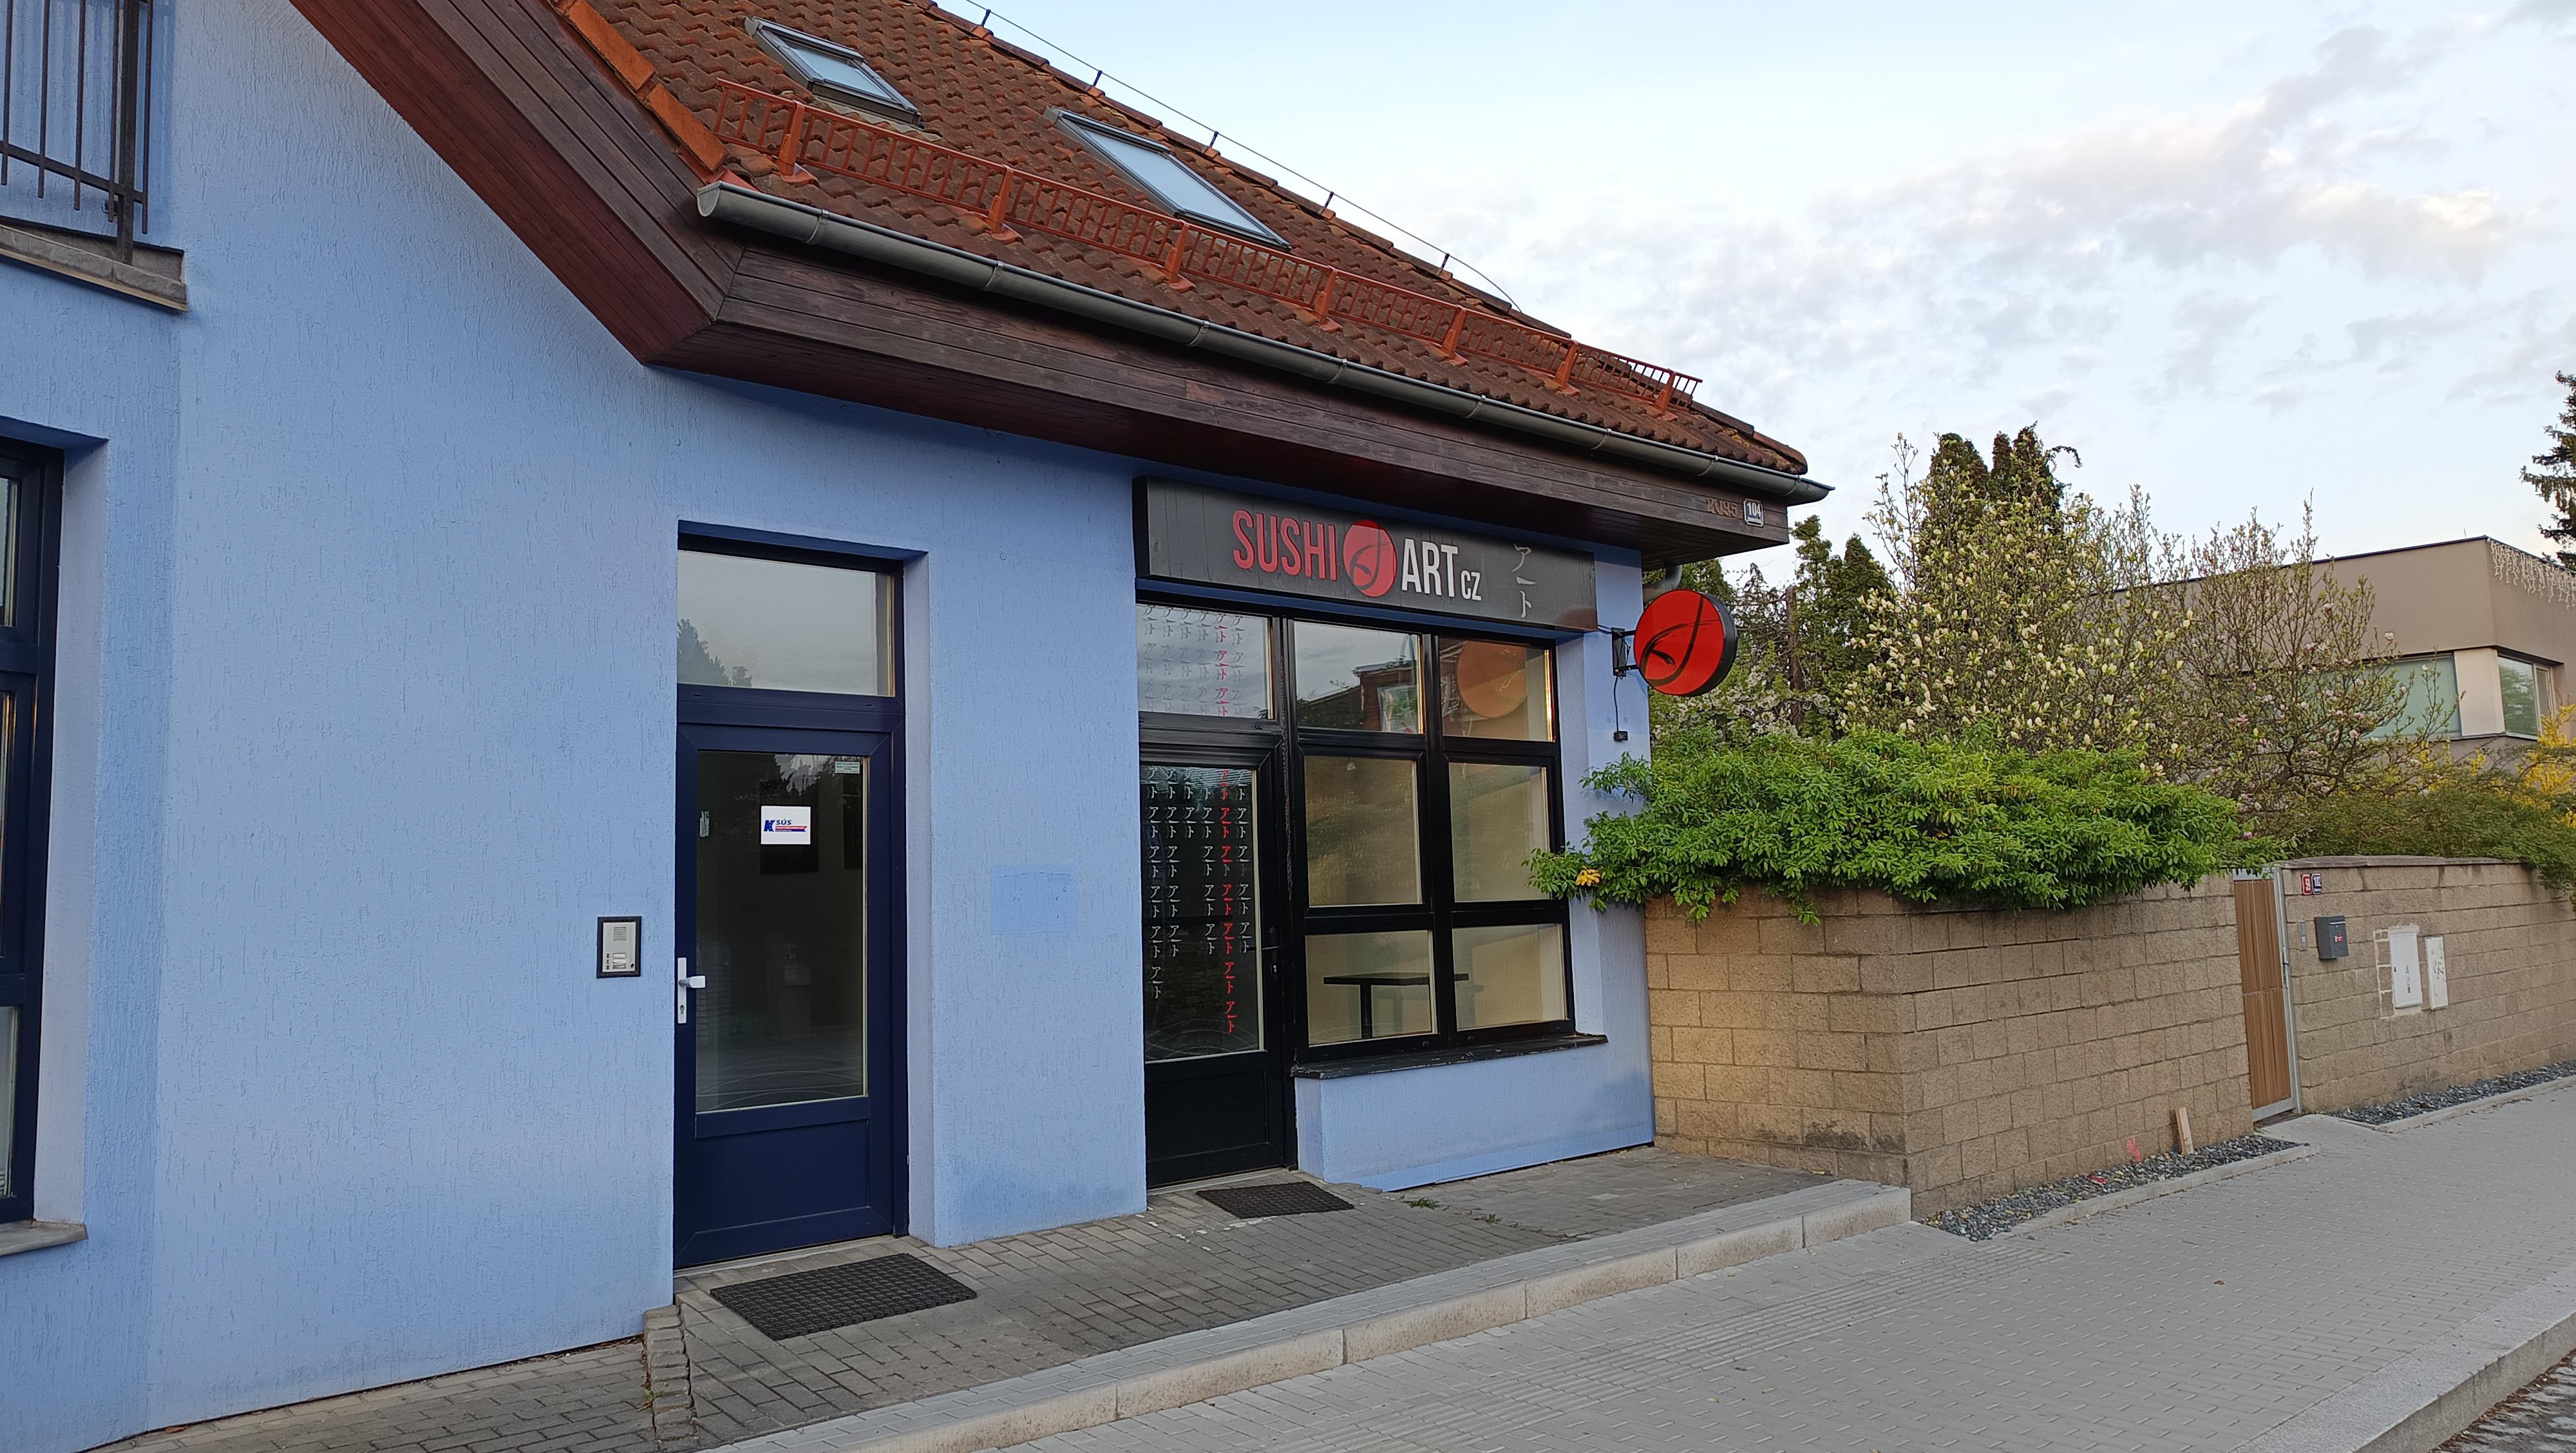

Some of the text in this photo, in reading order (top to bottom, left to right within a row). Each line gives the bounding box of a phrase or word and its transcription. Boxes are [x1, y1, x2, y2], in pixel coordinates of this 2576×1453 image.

[1747, 502, 1761, 517] 104
[1233, 509, 1338, 582] SUSHI
[1401, 537, 1459, 598] ART
[1511, 543, 1537, 619] アート
